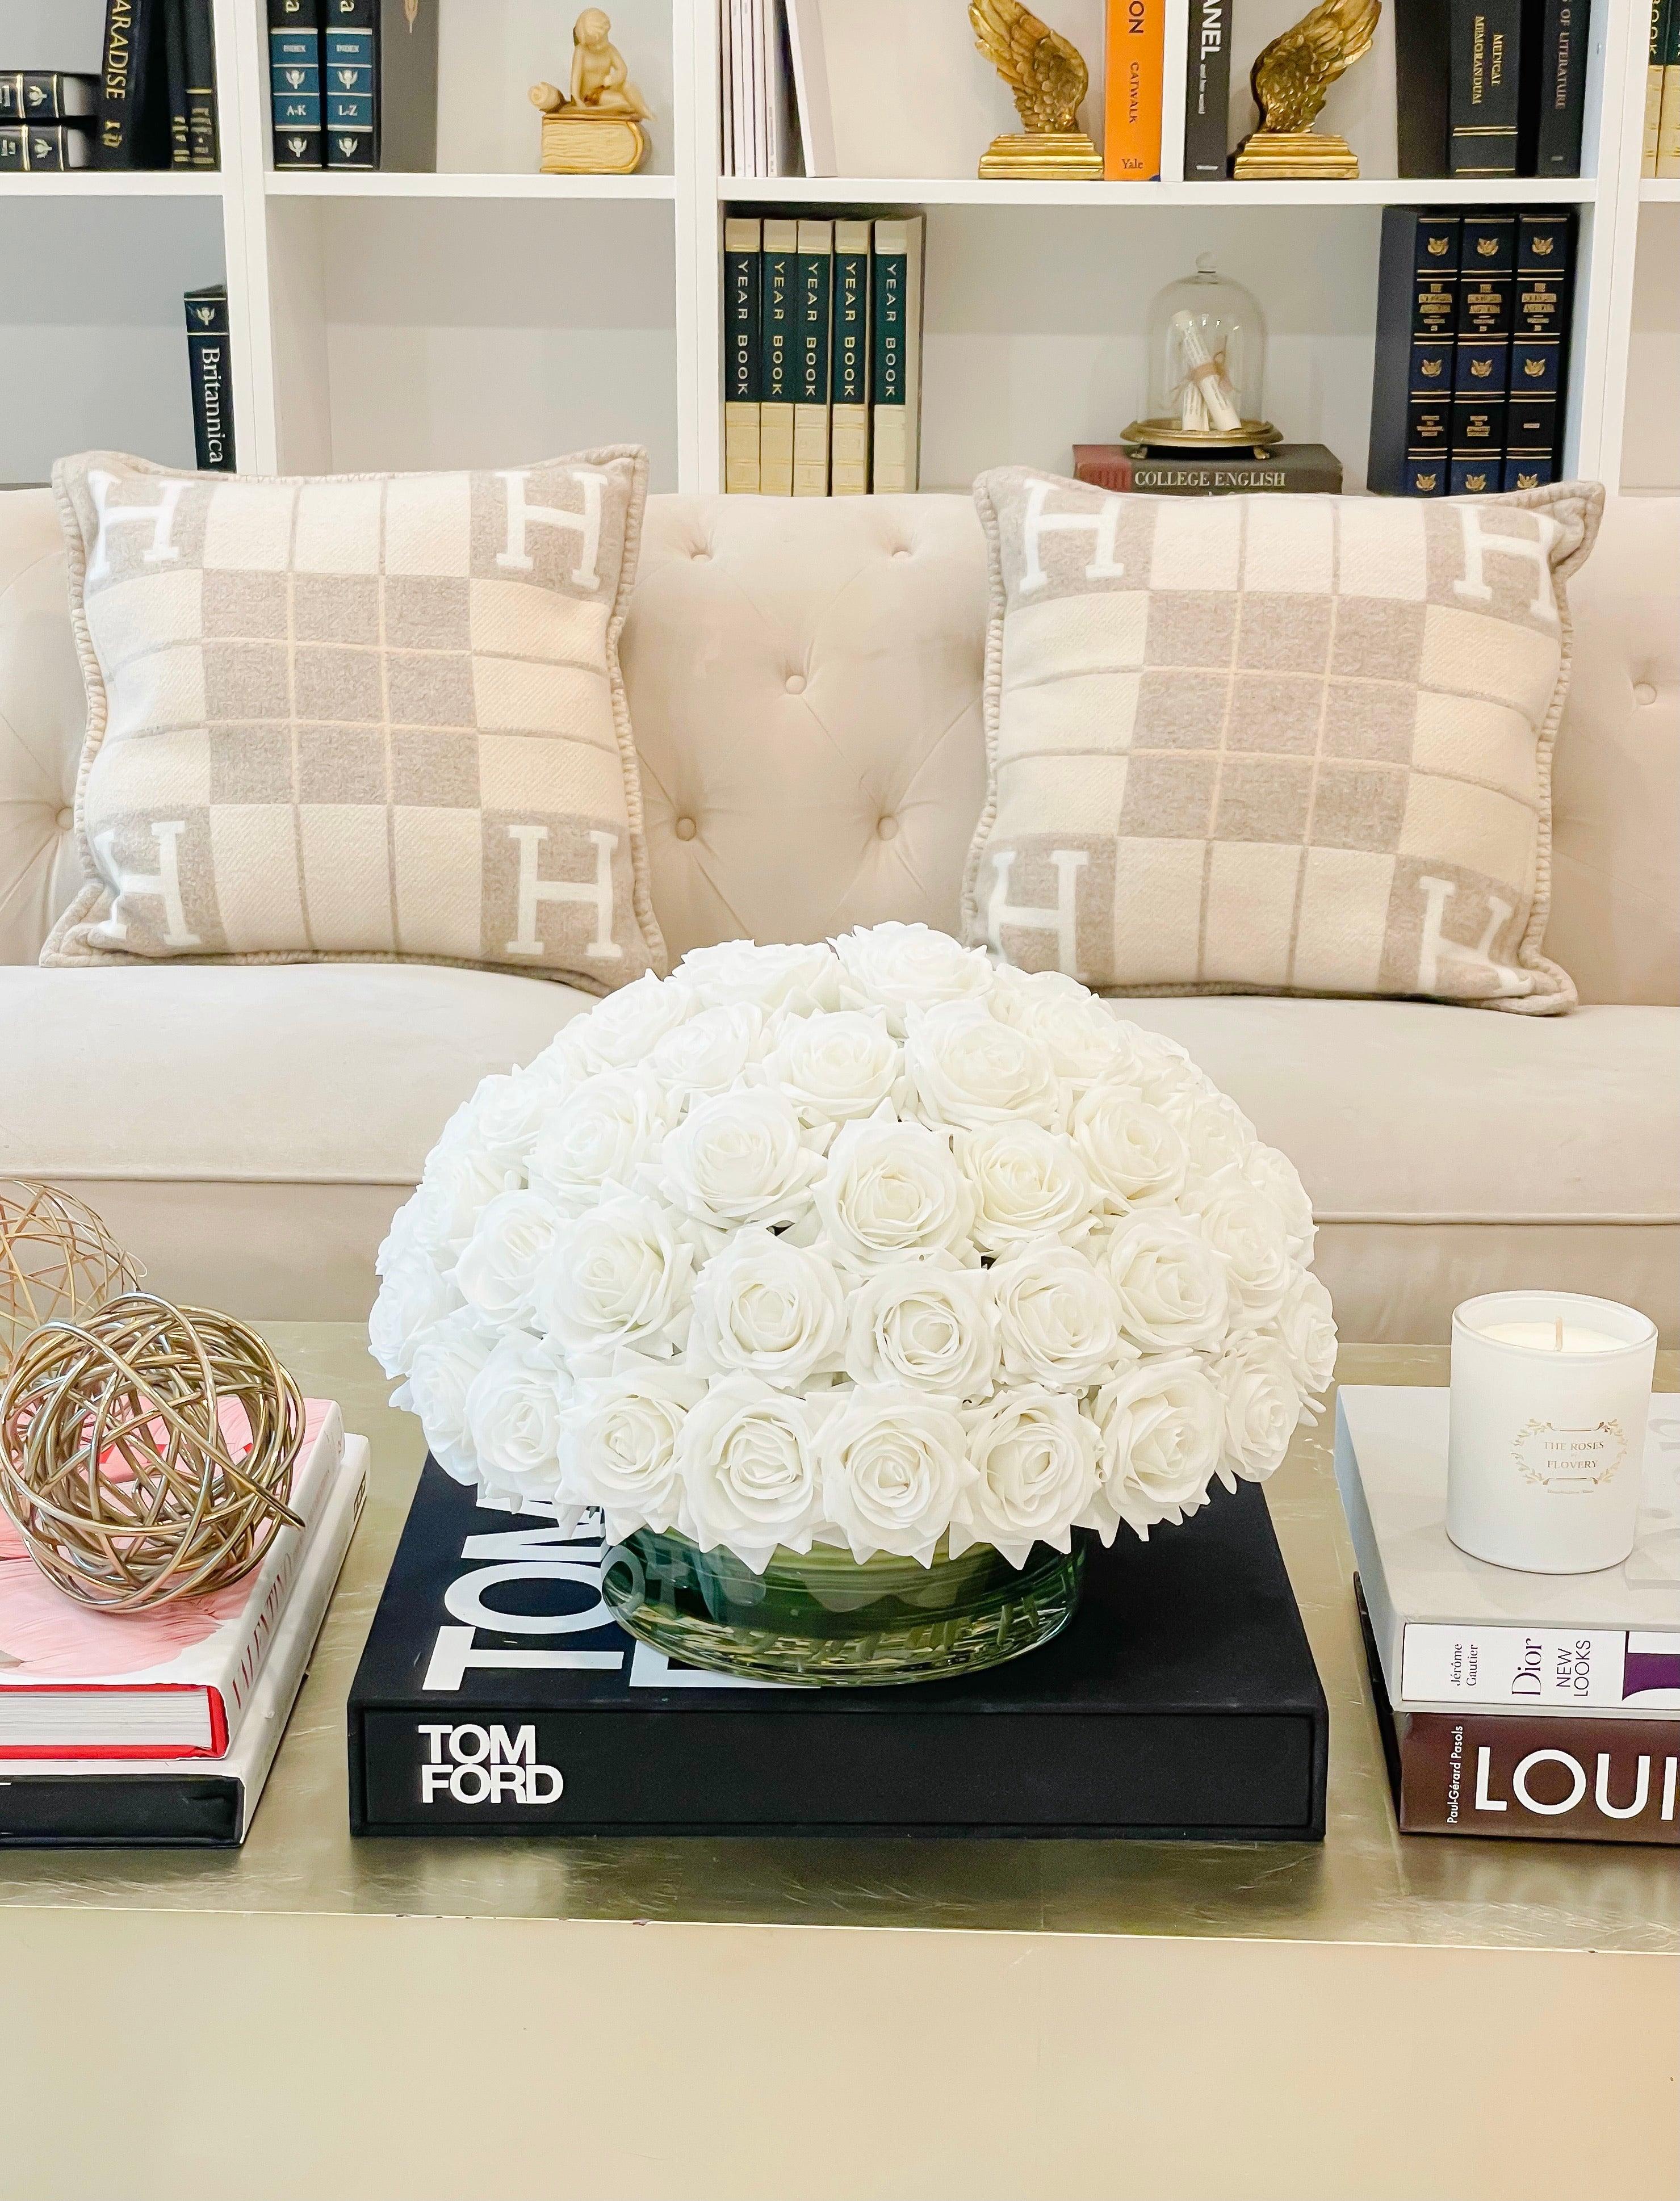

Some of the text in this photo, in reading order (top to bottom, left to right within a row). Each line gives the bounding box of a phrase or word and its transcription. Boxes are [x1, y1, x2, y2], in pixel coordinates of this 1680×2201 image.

[1128, 1, 1145, 33] ON
[1560, 9, 1570, 26] OF
[106, 0, 132, 99] ARADISE
[1556, 32, 1570, 109] LITERATURE
[287, 104, 307, 116] A-K
[339, 104, 358, 116] L-Z
[1129, 61, 1139, 124] CATWALK
[1121, 158, 1143, 169] Yale
[738, 259, 748, 395] YEAR BOOK
[772, 261, 785, 395] YEAR BOOK
[805, 262, 819, 396] YEAR BOOK
[844, 261, 857, 397] YEAR BOOK
[885, 263, 897, 397] YEAR BOOK
[202, 347, 225, 464] Britannica
[1135, 471, 1286, 487] COLLEGE ENGLISH
[87, 469, 195, 584] H
[495, 470, 609, 590] H
[1020, 478, 1125, 594] H
[505, 824, 623, 959] H
[1544, 1441, 1604, 1451] THE ROSES
[1547, 1460, 1598, 1469] FLOVERY
[422, 1496, 623, 1691] TOM
[1450, 1643, 1463, 1686] Jérôme
[1466, 1644, 1478, 1686] Gautier
[1511, 1637, 1542, 1696] Dior
[1556, 1647, 1573, 1687] NEW
[1573, 1640, 1591, 1696] LOOKS
[418, 1724, 535, 1764] TOM
[1447, 1725, 1464, 1824] Paul-Gérard Pasols
[421, 1763, 564, 1804] FORD
[1475, 1746, 1678, 1821] LOUI
